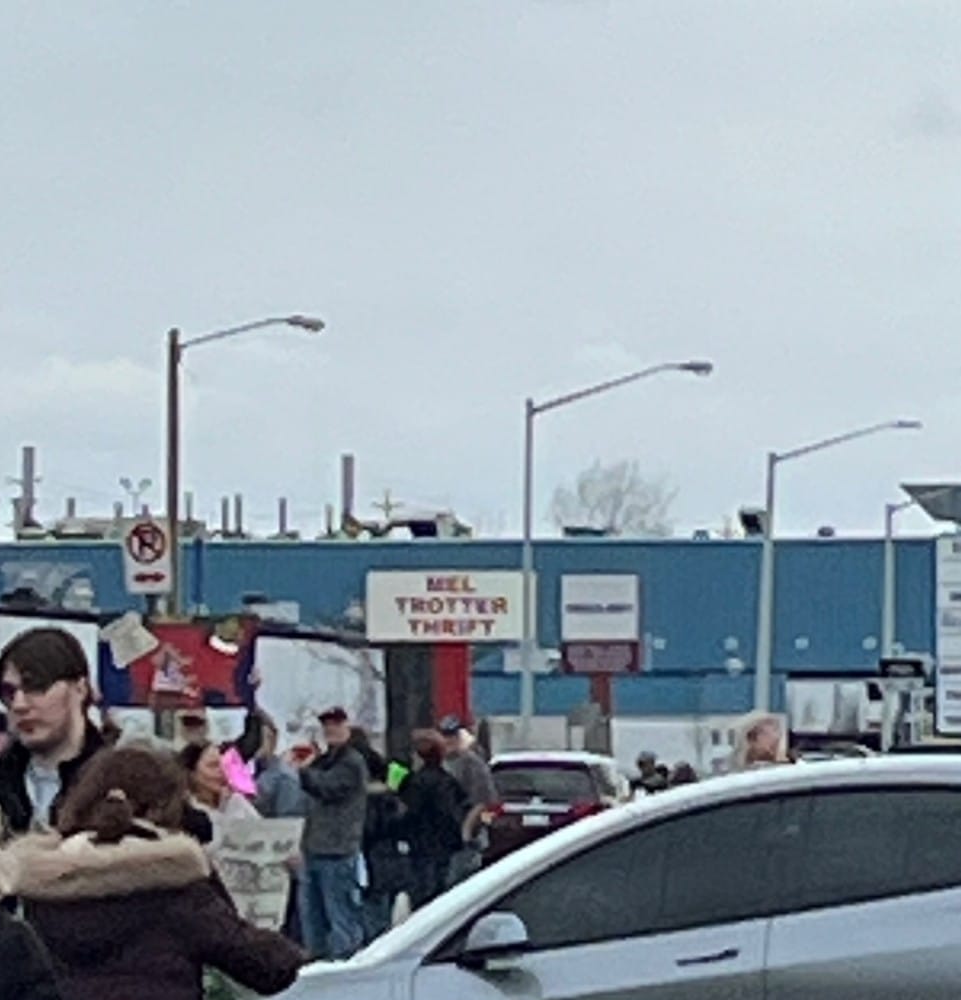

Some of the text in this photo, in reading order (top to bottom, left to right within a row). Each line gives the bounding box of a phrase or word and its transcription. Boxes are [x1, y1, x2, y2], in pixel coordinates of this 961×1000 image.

[426, 575, 476, 593] MEL
[395, 596, 508, 615] TROTTER
[408, 618, 496, 636] THRIFT
